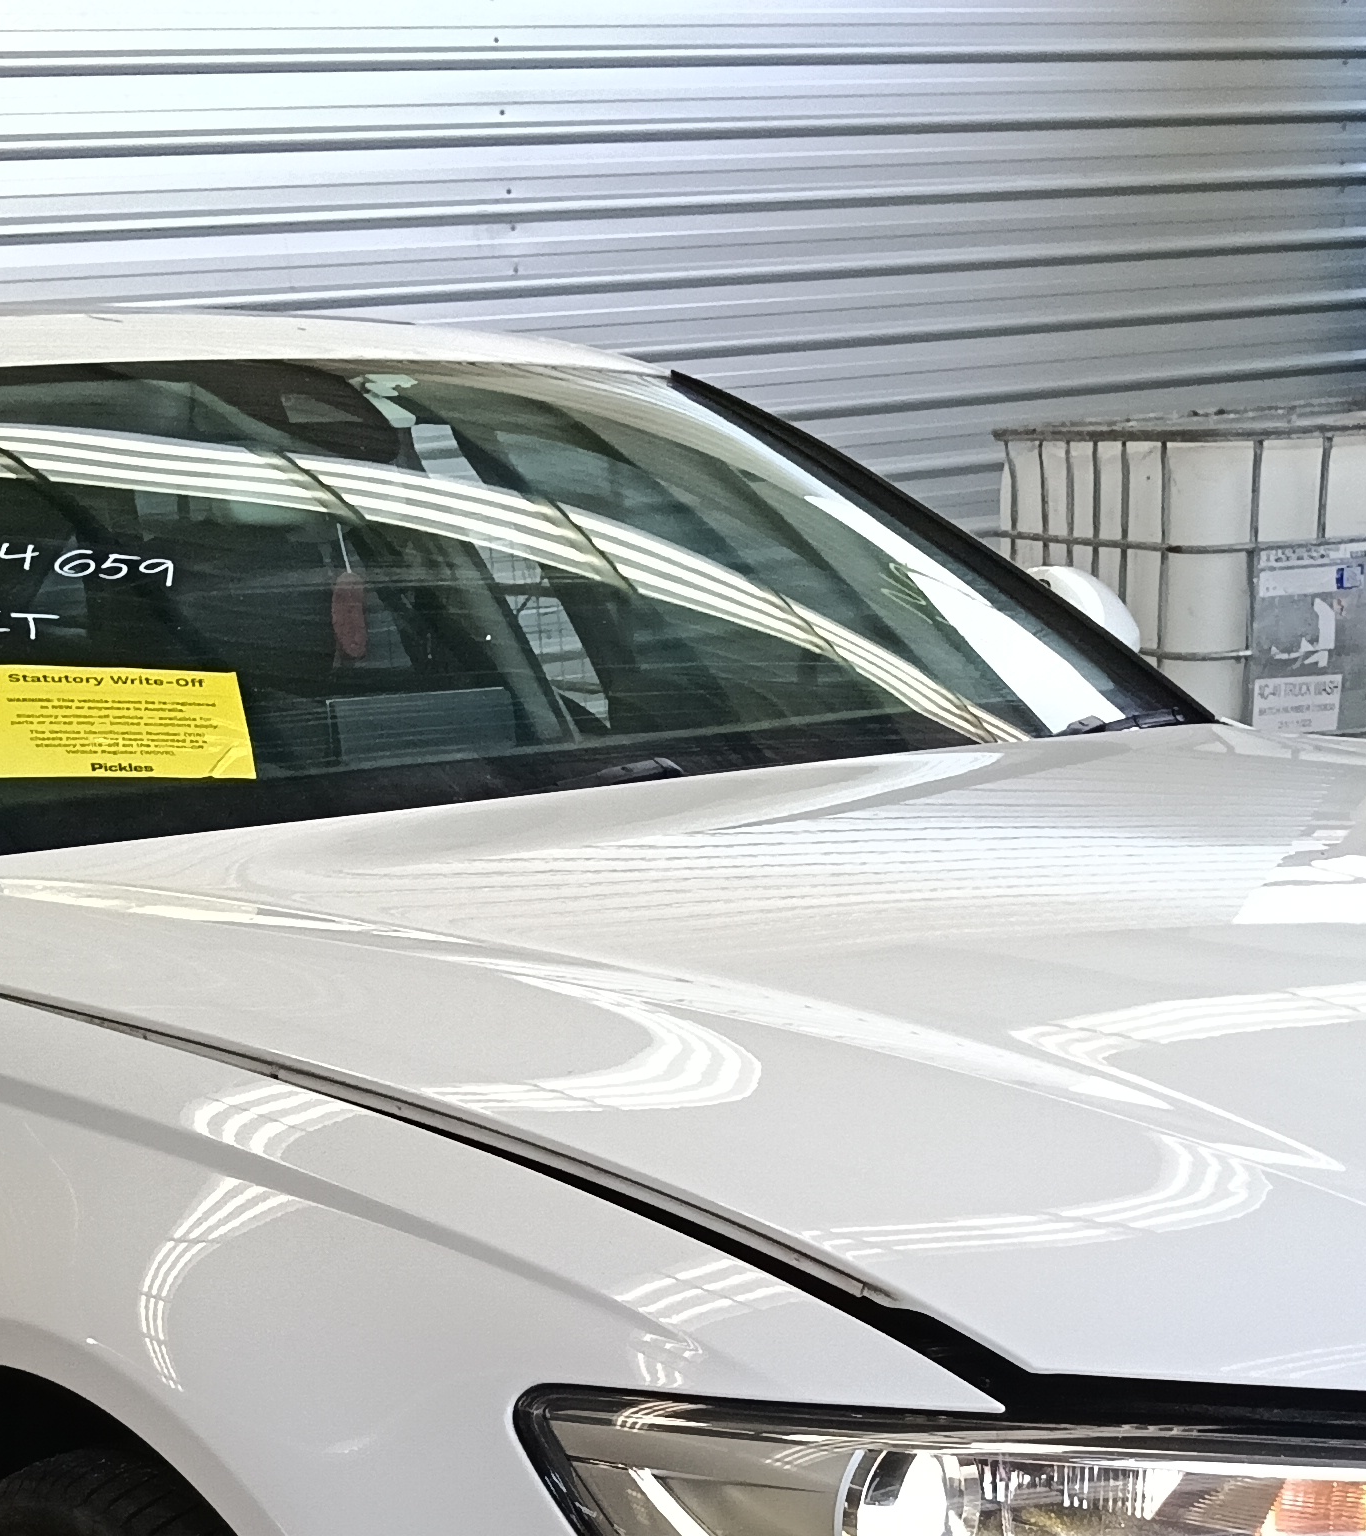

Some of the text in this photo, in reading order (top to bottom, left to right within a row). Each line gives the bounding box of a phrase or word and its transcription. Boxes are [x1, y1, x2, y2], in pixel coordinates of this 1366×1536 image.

[7, 673, 205, 688] Statutory Write-Off
[90, 762, 155, 772] Pickles
